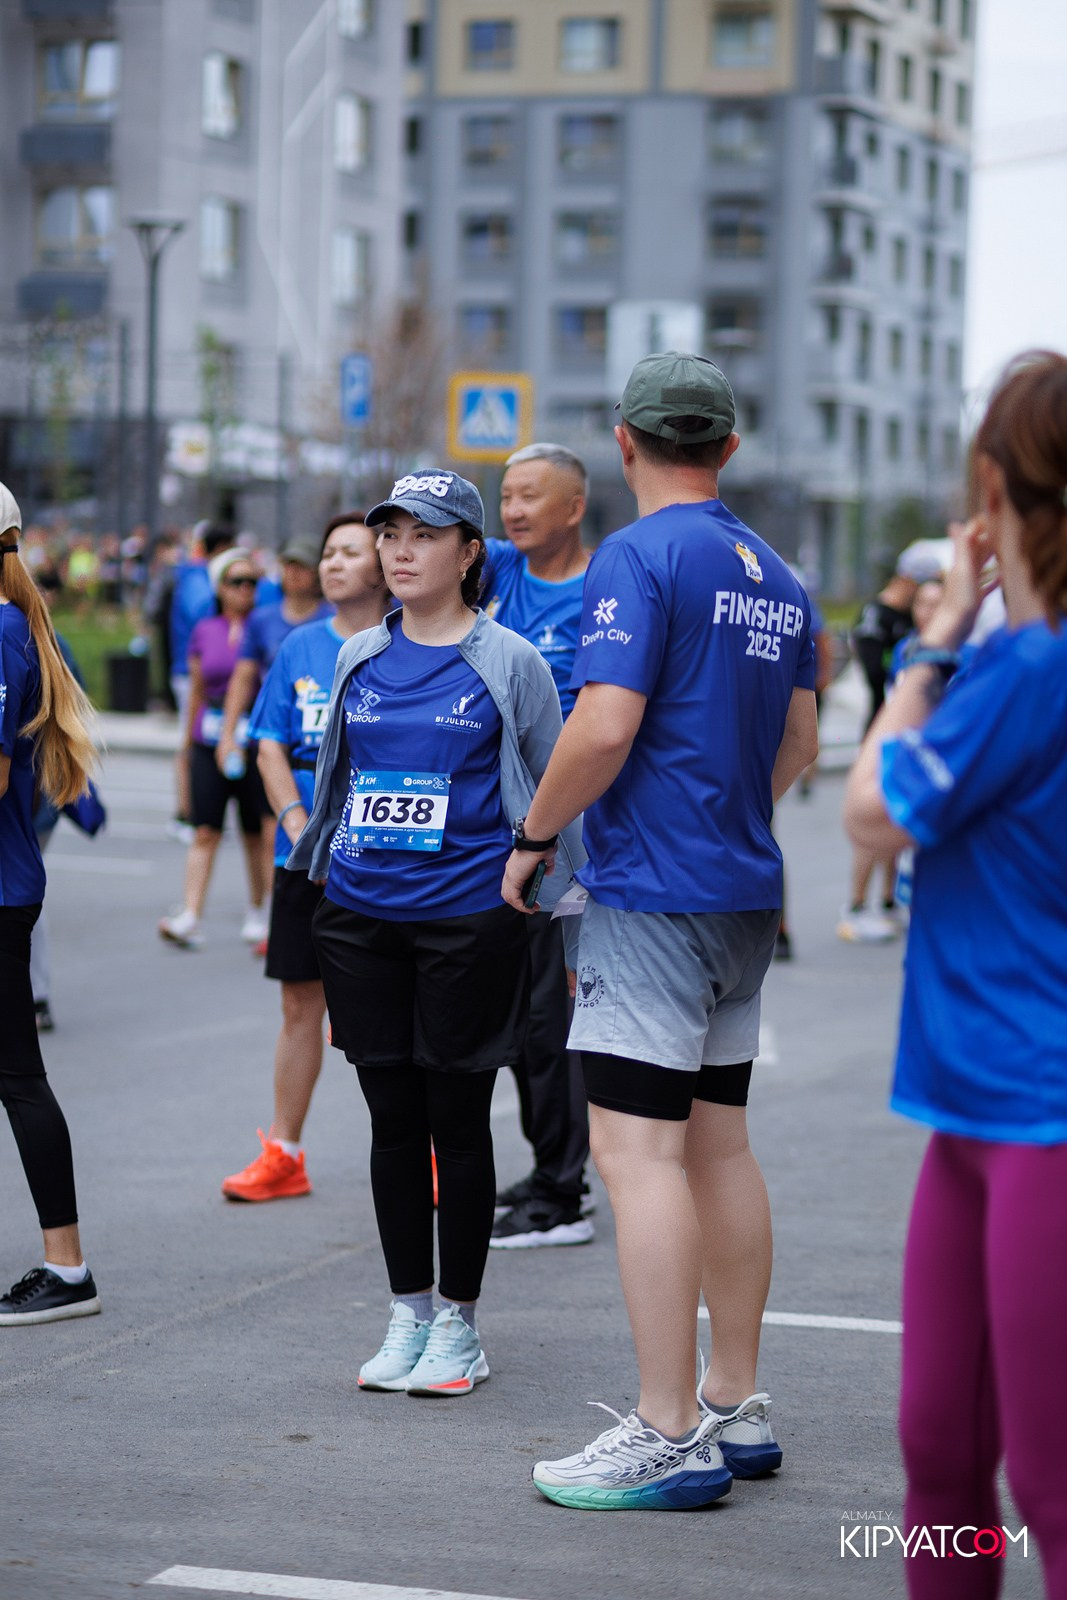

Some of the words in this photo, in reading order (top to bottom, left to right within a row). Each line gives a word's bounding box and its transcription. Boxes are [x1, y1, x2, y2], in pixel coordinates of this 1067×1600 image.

[607, 628, 633, 645] City
[745, 629, 781, 662] 2025
[351, 714, 381, 724] GROUP
[444, 716, 482, 730] JULDYZAI
[358, 775, 365, 785] 5
[361, 795, 435, 826] 1638
